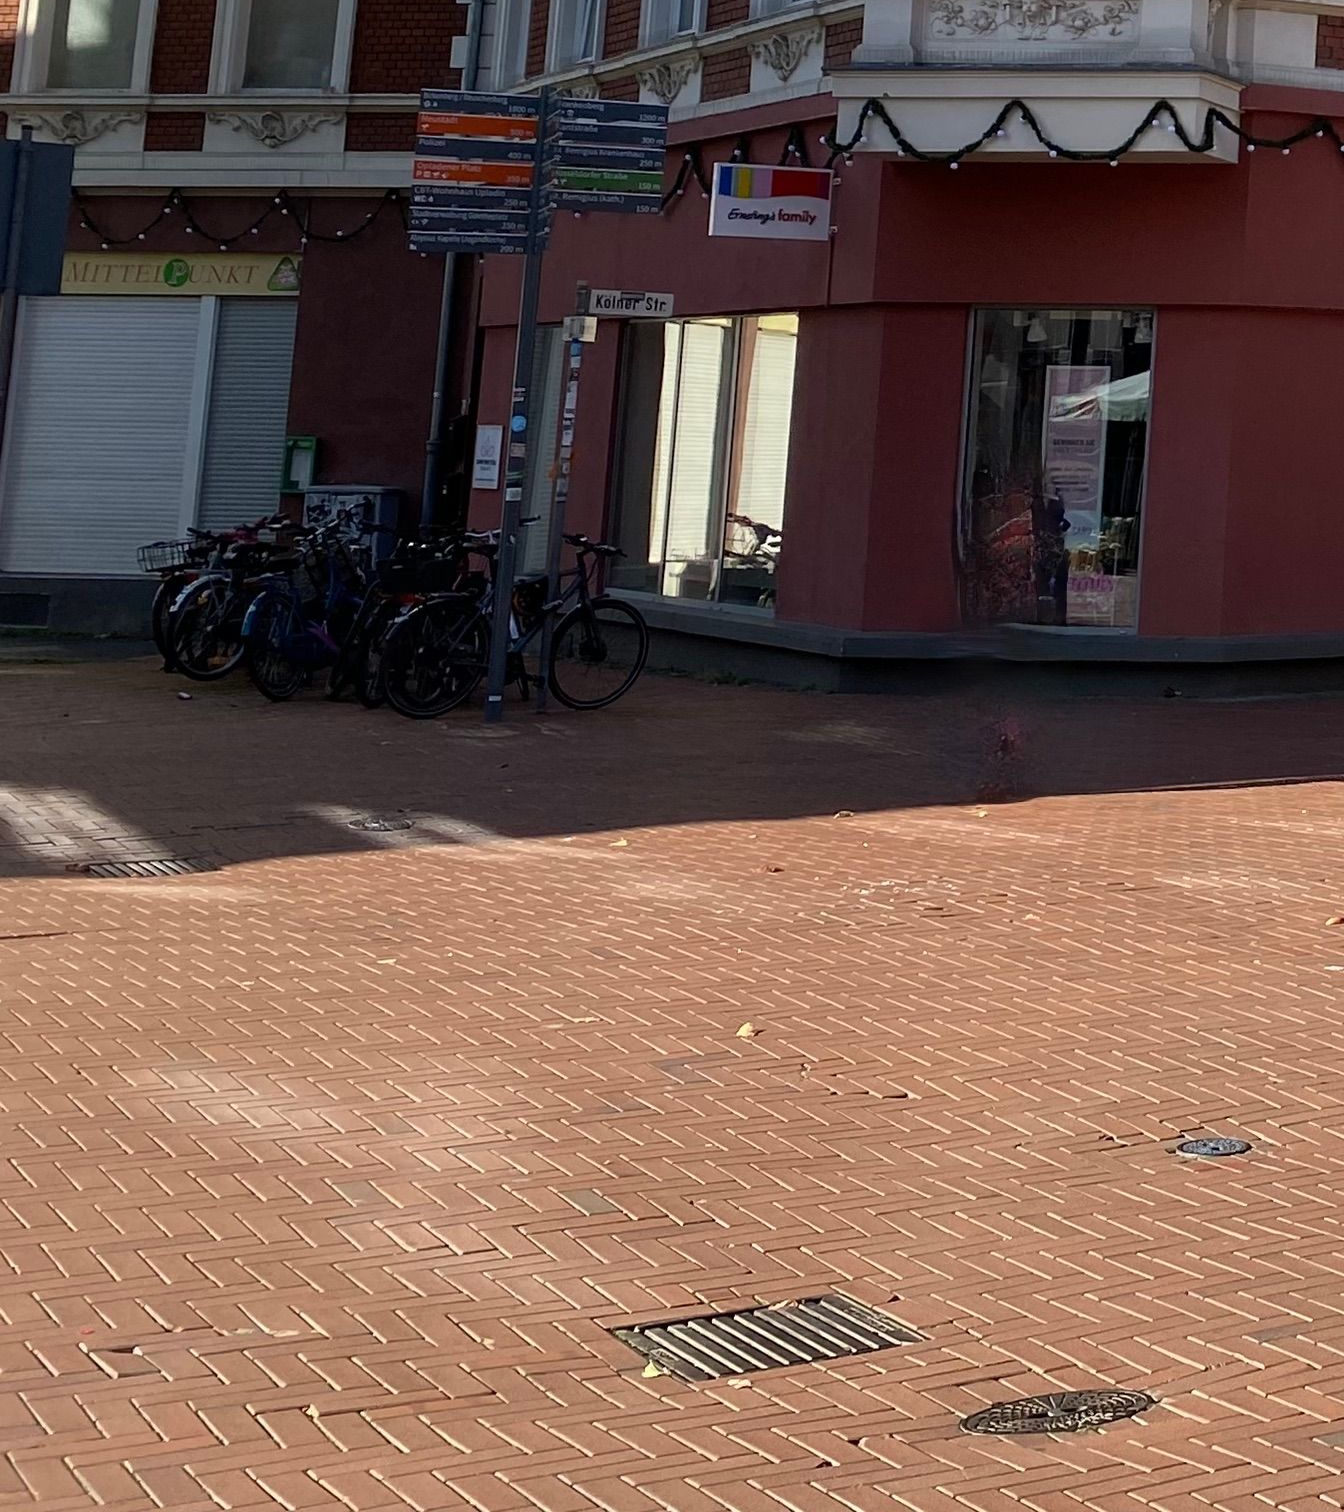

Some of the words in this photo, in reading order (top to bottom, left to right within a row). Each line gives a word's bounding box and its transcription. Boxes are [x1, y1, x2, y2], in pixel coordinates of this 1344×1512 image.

[419, 139, 446, 147] Polizei
[728, 208, 776, 225] Ernsting's
[778, 209, 817, 225] family
[65, 261, 260, 285] MITTELPUNKT
[595, 294, 641, 311] Kölner
[645, 296, 667, 312] Str.
